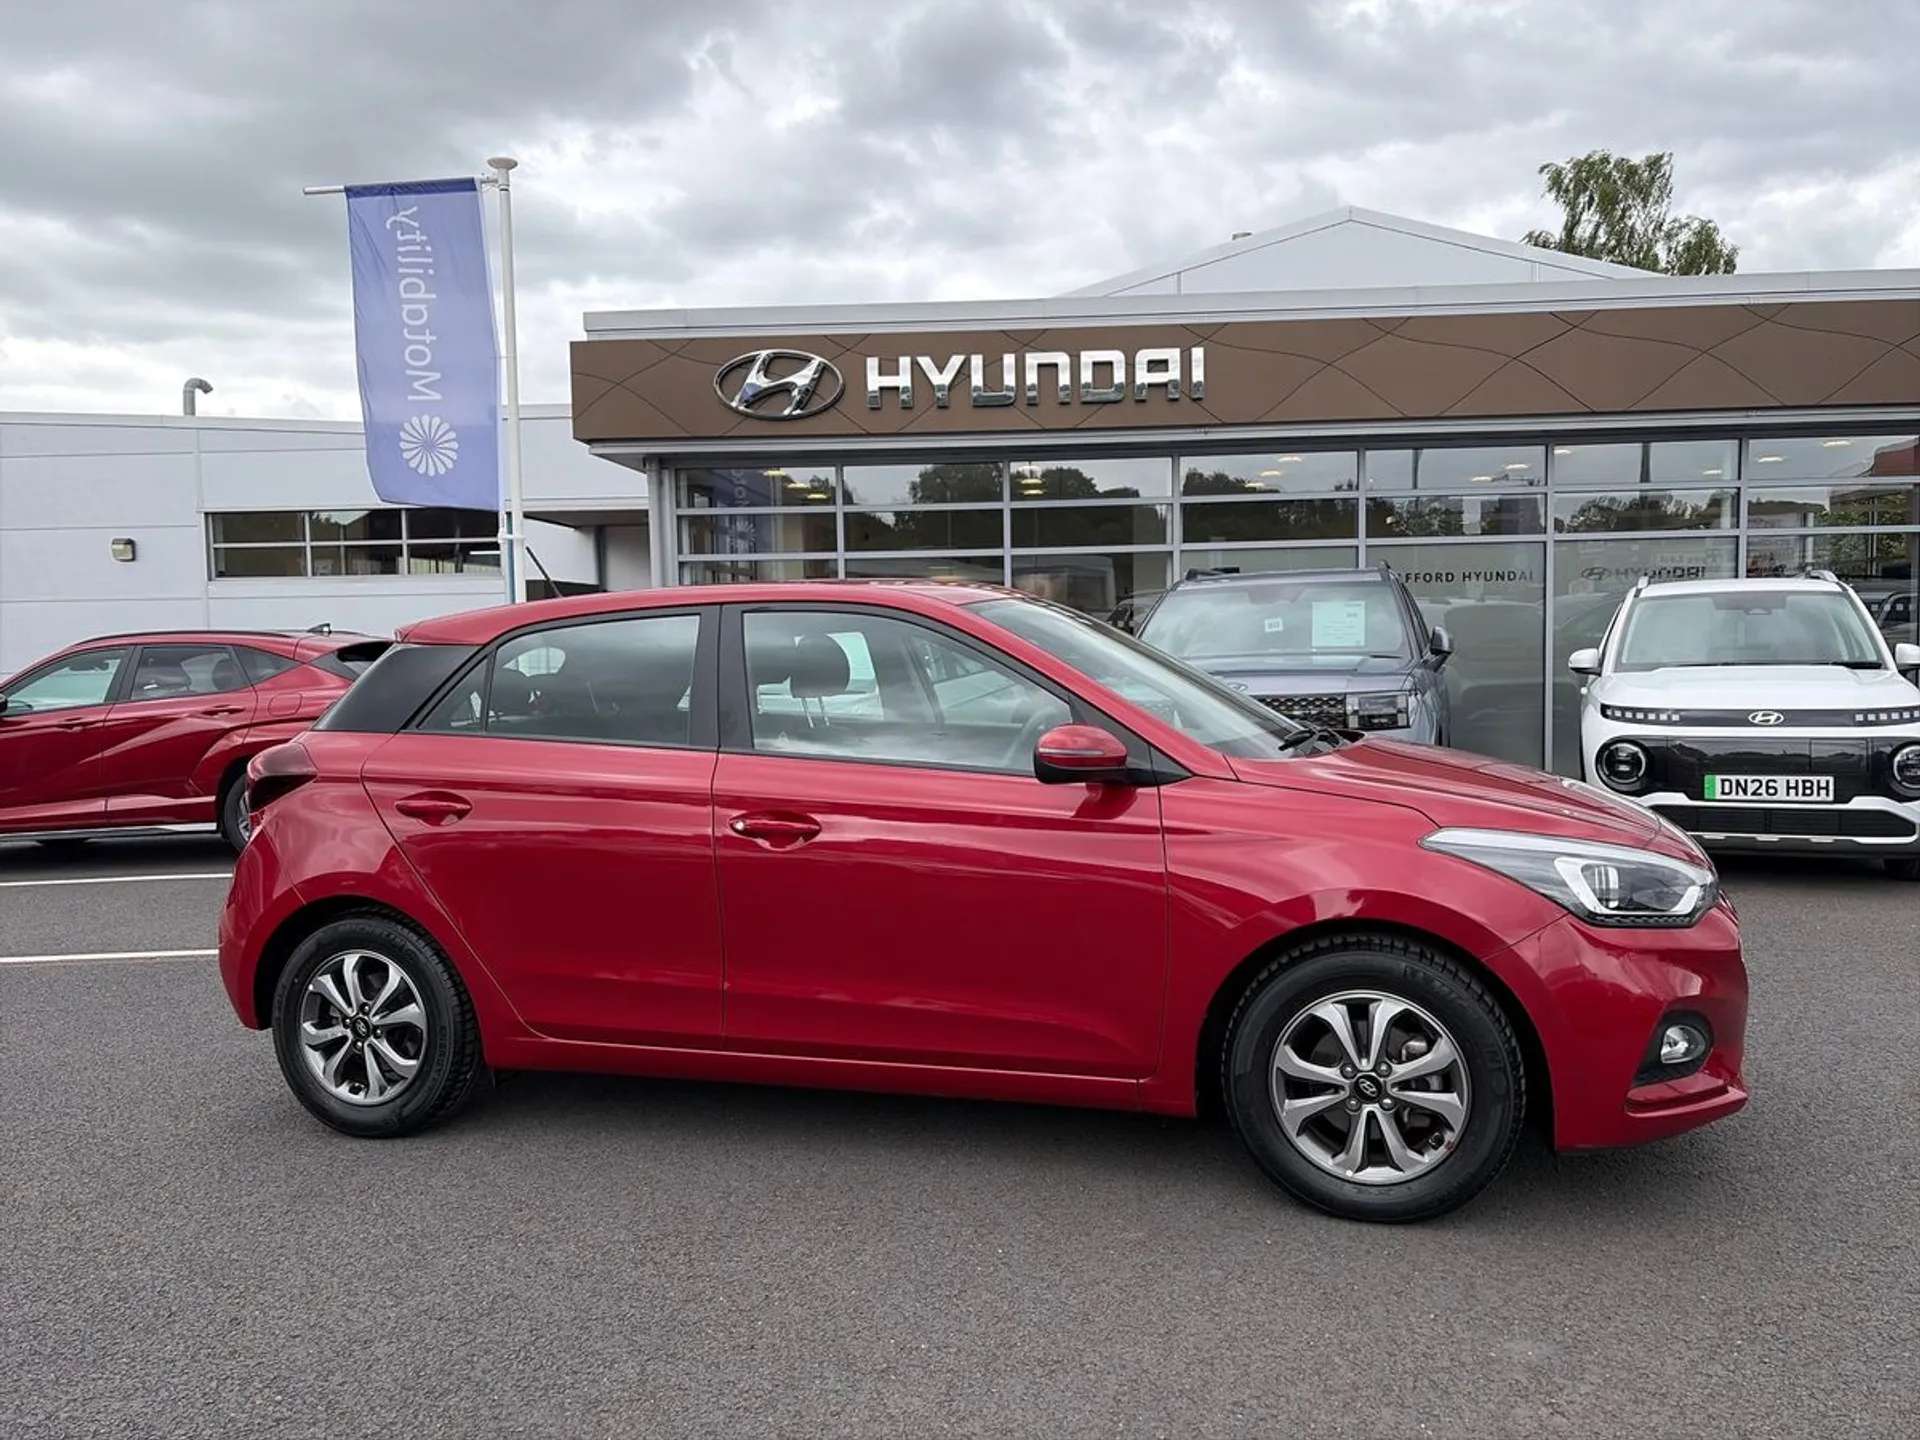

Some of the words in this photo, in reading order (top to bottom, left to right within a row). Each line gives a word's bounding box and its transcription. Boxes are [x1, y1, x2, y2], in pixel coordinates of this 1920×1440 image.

[866, 347, 1205, 409] HYUNDAI
[1397, 571, 1454, 583] FFORD
[1462, 570, 1533, 582] HYUNDAI
[1720, 778, 1778, 796] DN26
[1786, 779, 1830, 797] HBH
